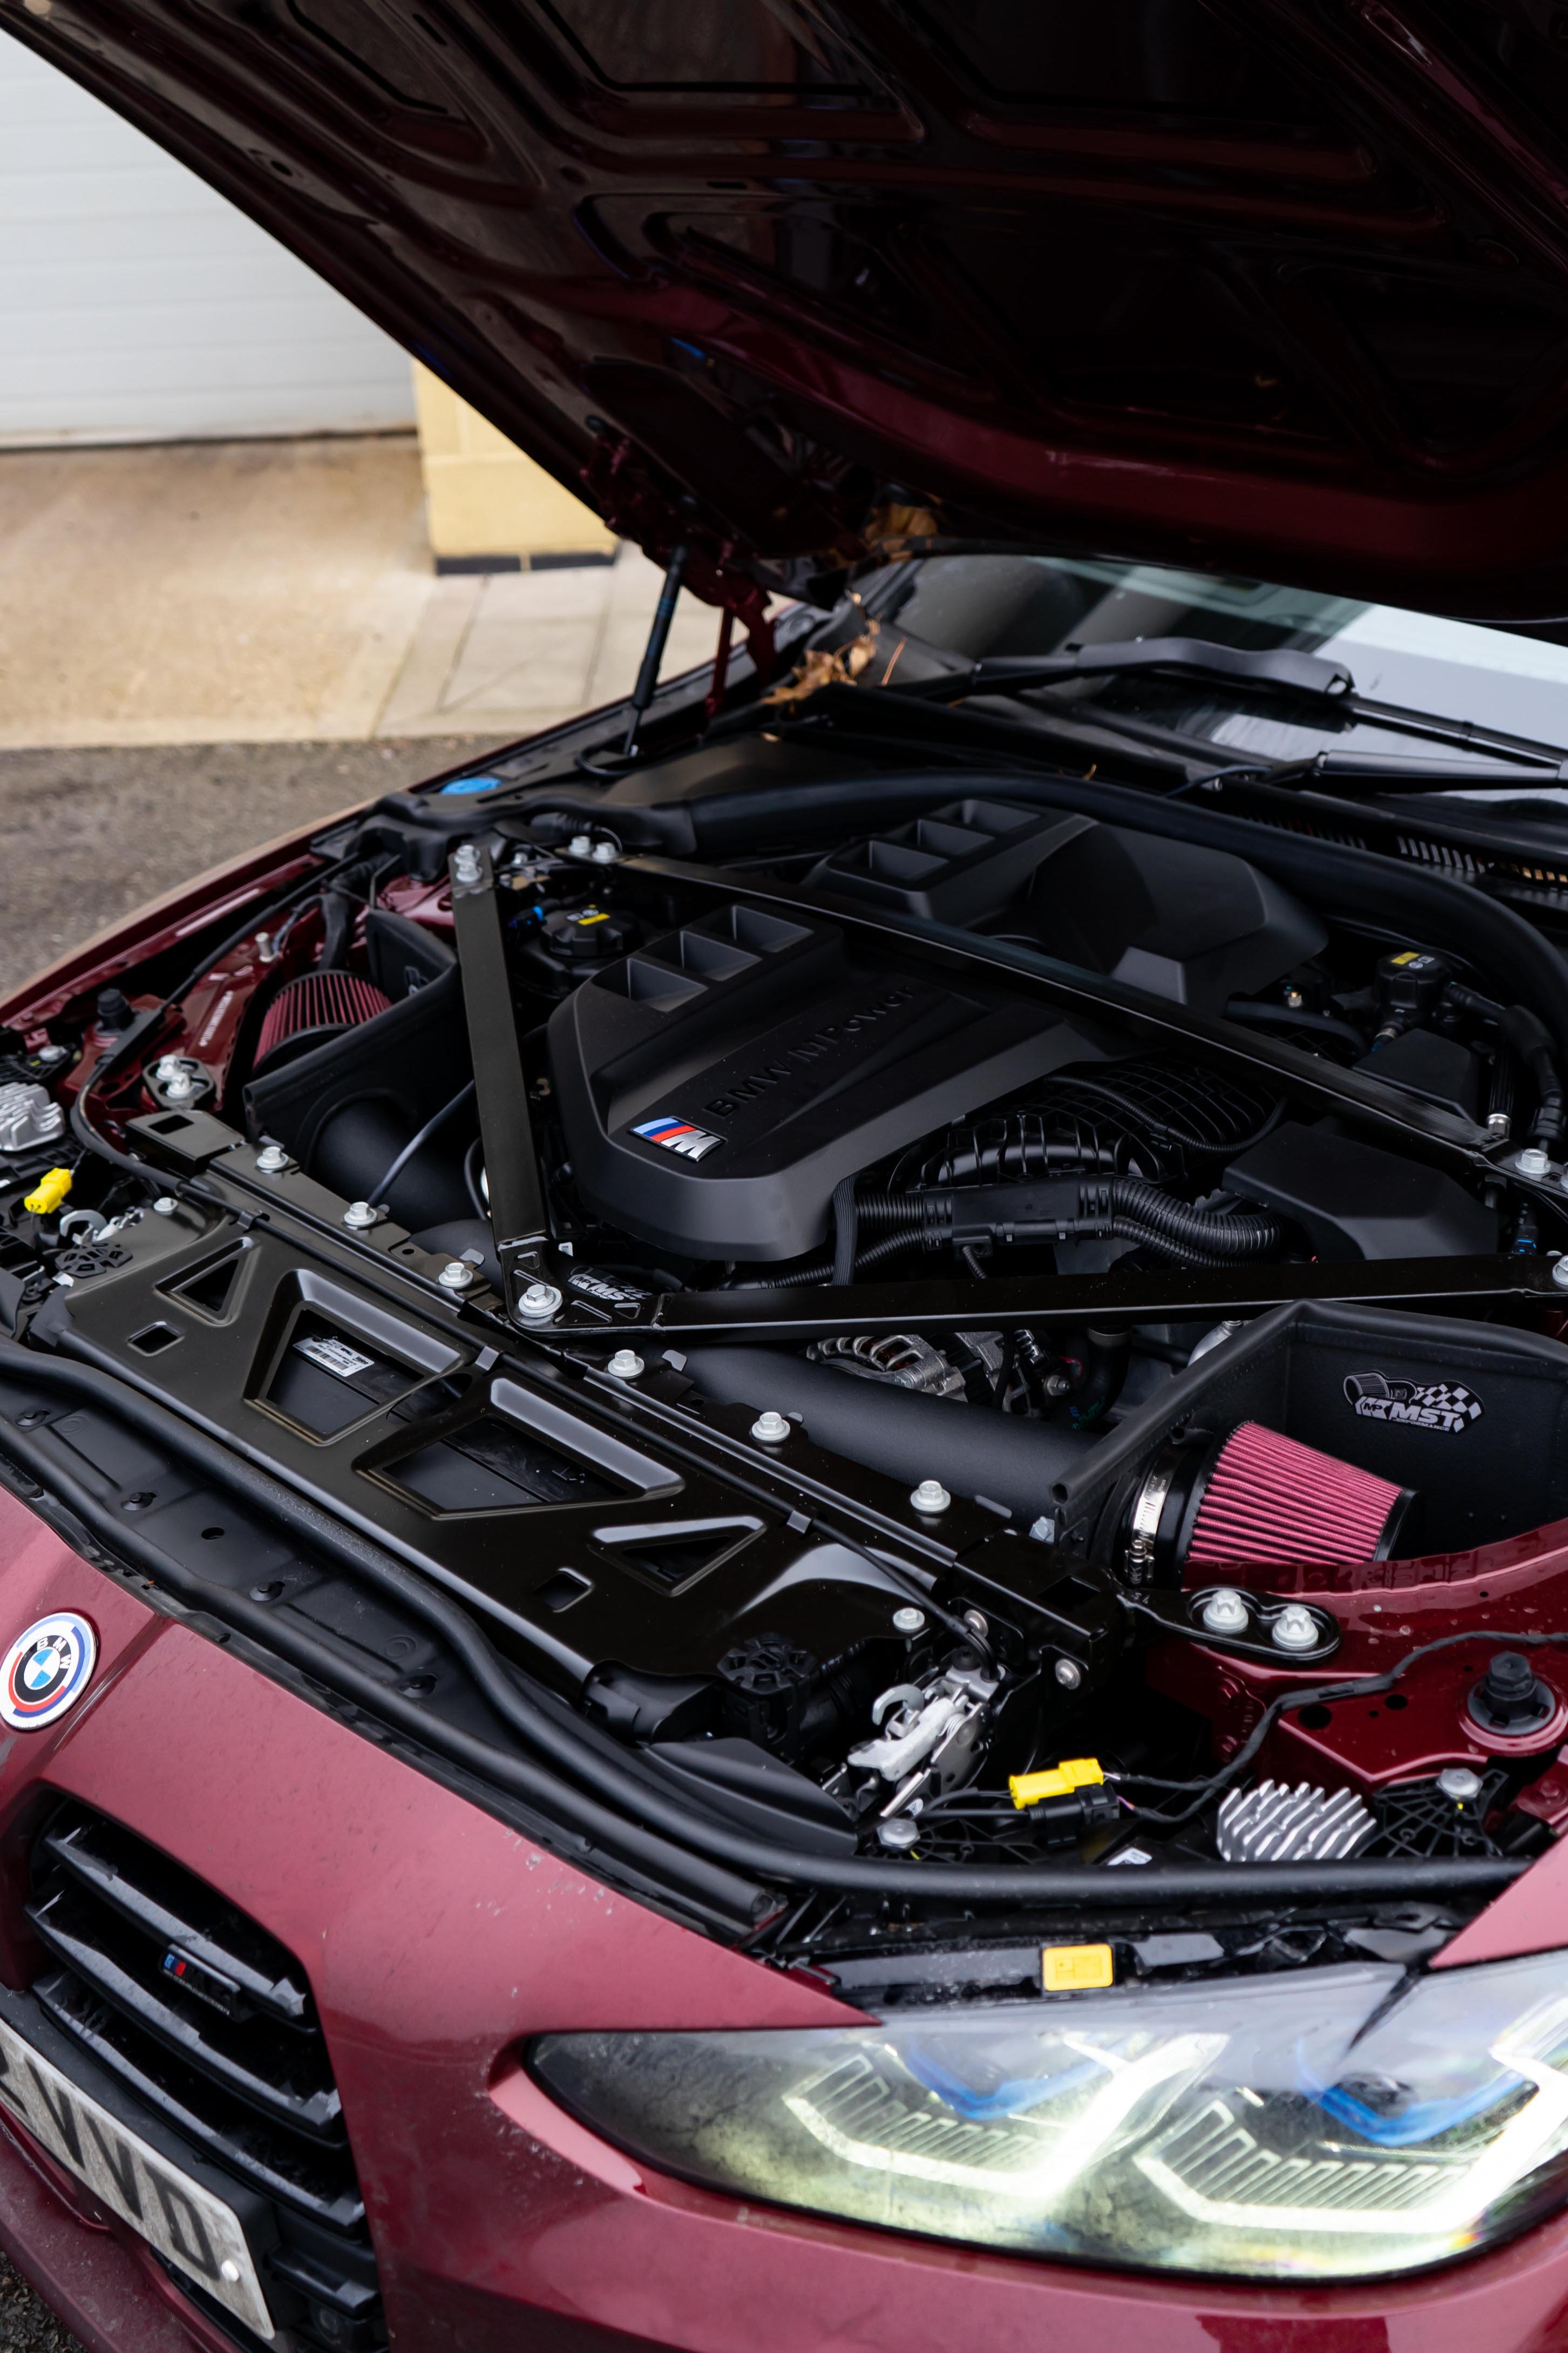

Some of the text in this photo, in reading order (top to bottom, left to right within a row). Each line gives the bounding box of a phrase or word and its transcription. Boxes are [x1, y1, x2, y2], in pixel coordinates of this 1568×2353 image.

[702, 1060, 792, 1119] BMW
[1363, 1402, 1383, 1411] MP
[1389, 1402, 1461, 1429] MST
[1392, 1417, 1450, 1432] PERFORMANCE
[37, 1637, 71, 1669] BMW
